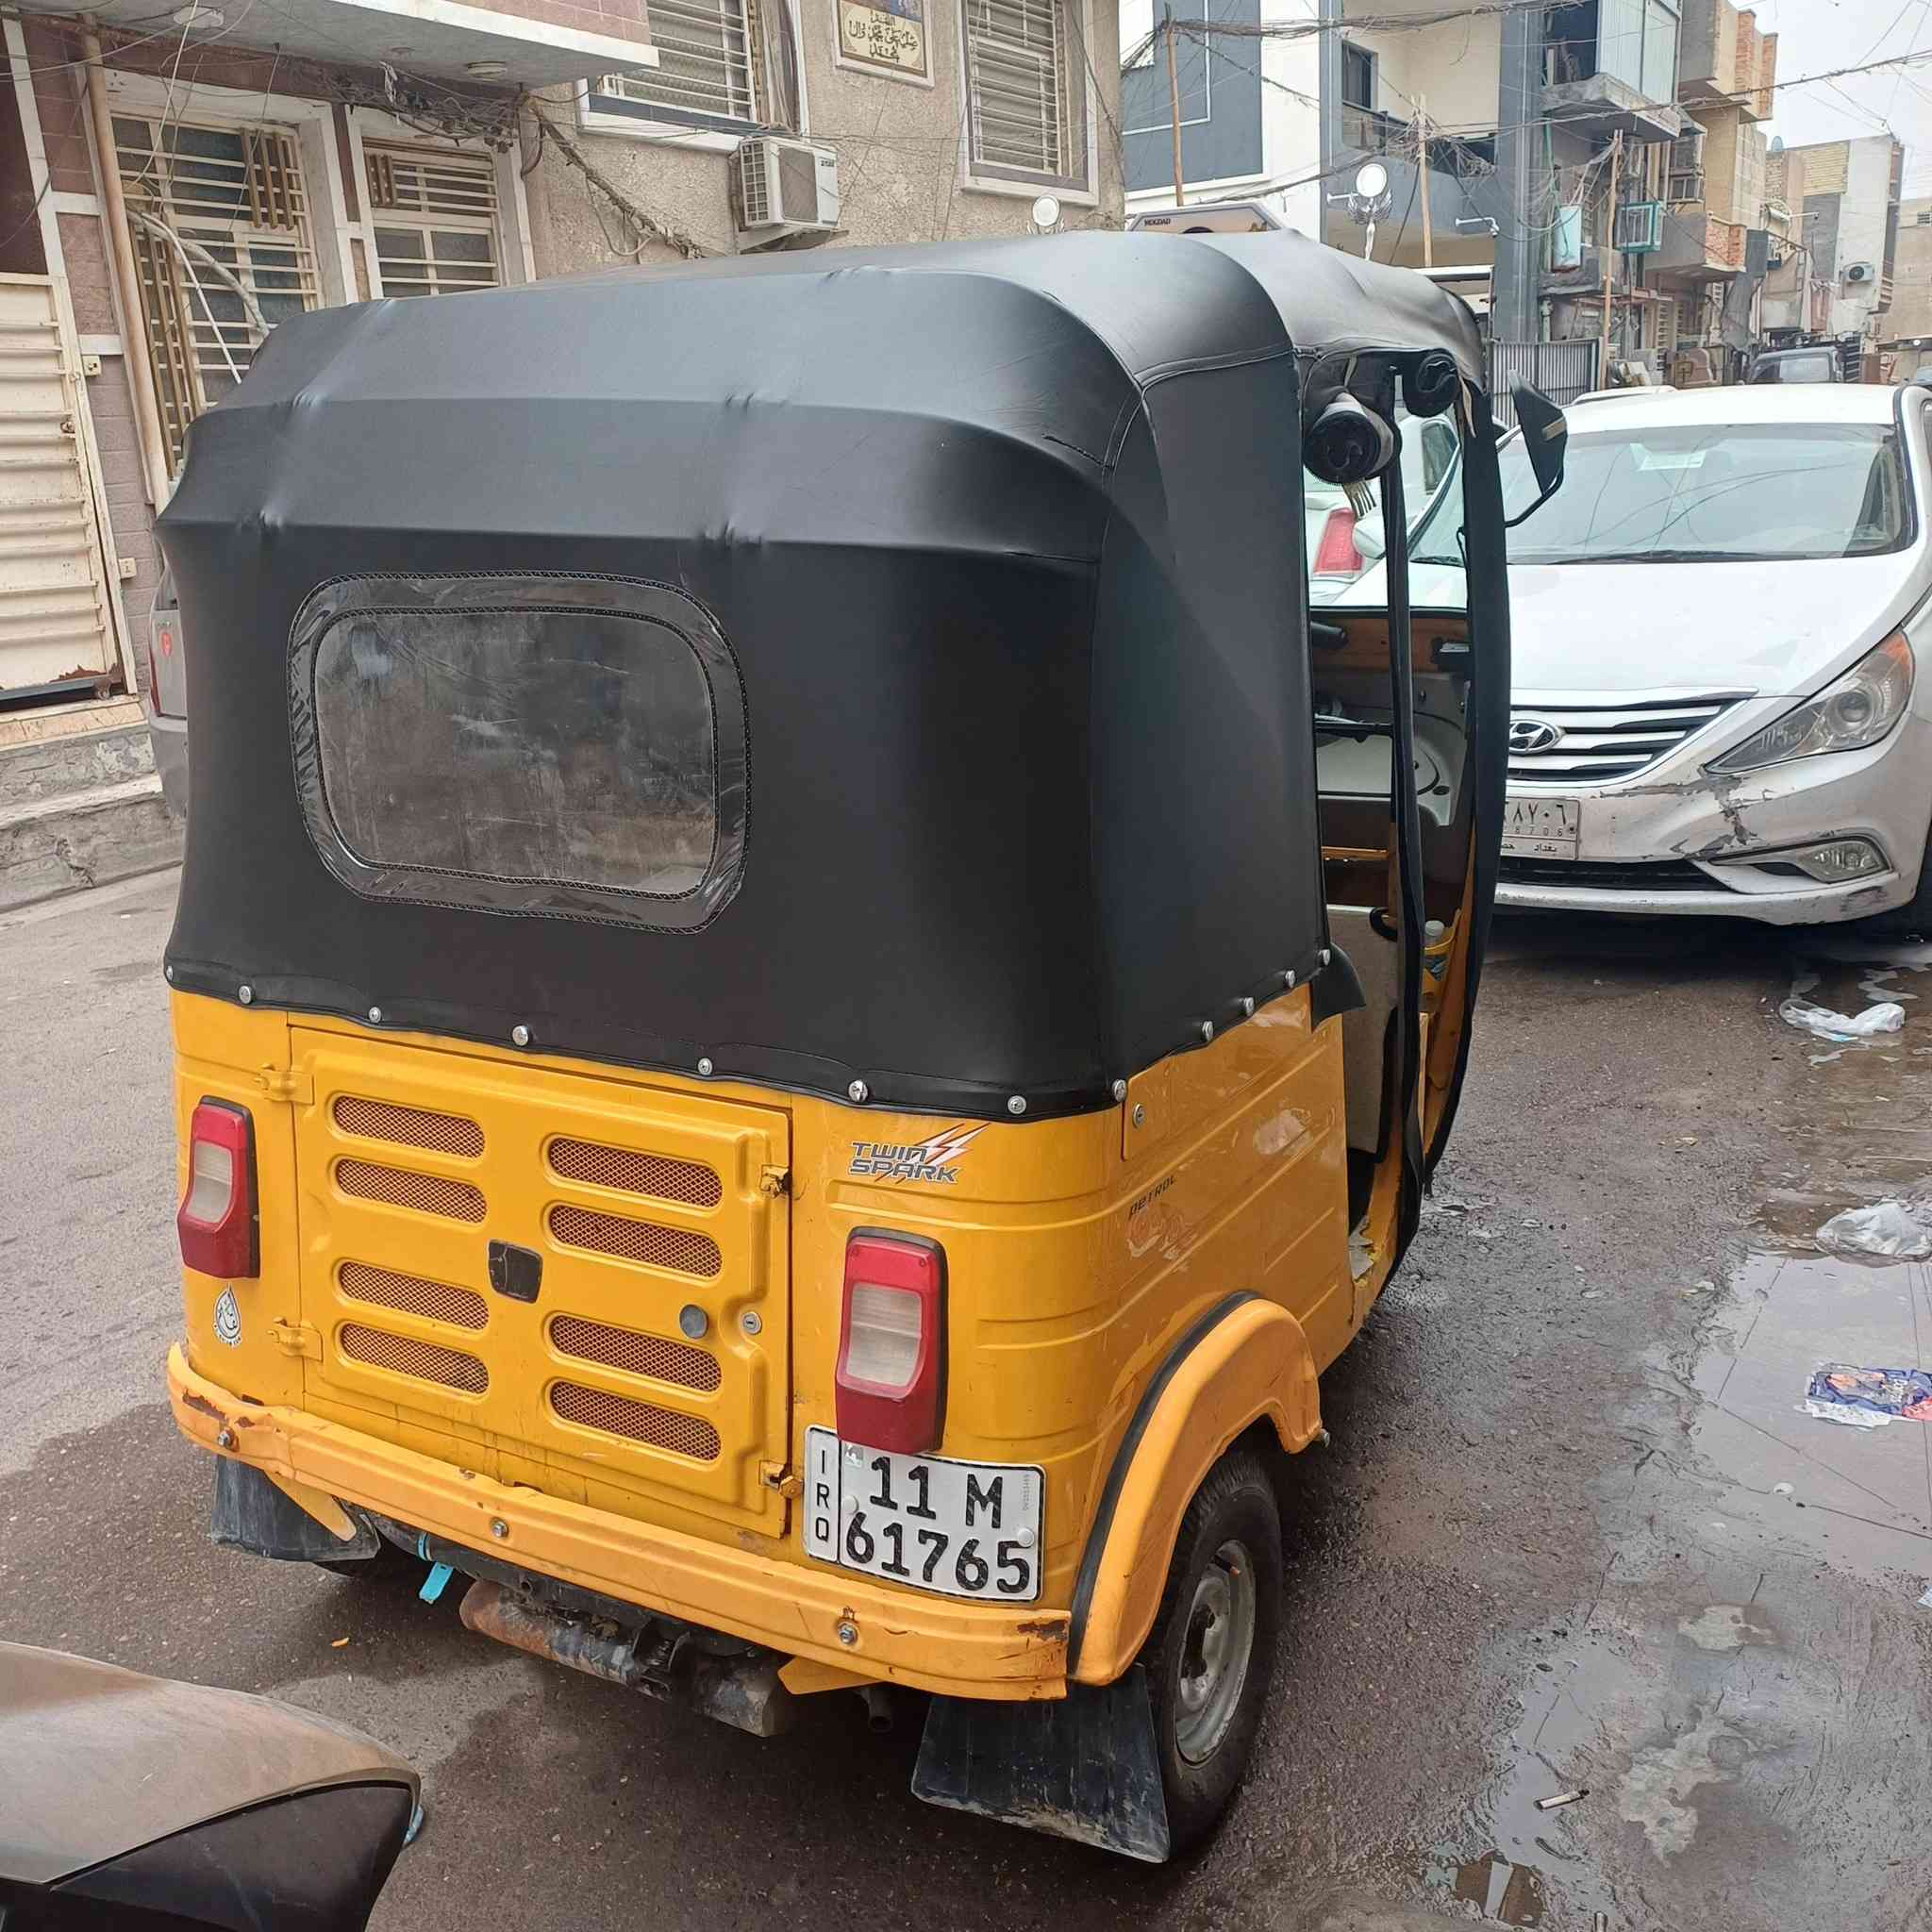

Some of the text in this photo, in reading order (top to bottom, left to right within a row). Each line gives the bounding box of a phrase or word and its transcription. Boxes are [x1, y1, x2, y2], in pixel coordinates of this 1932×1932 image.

[849, 1158, 958, 1182] SPARK
[851, 1141, 928, 1162] TWIN
[869, 1456, 937, 1521] 11
[965, 1474, 1004, 1529] M
[845, 1511, 1031, 1594] 61765
